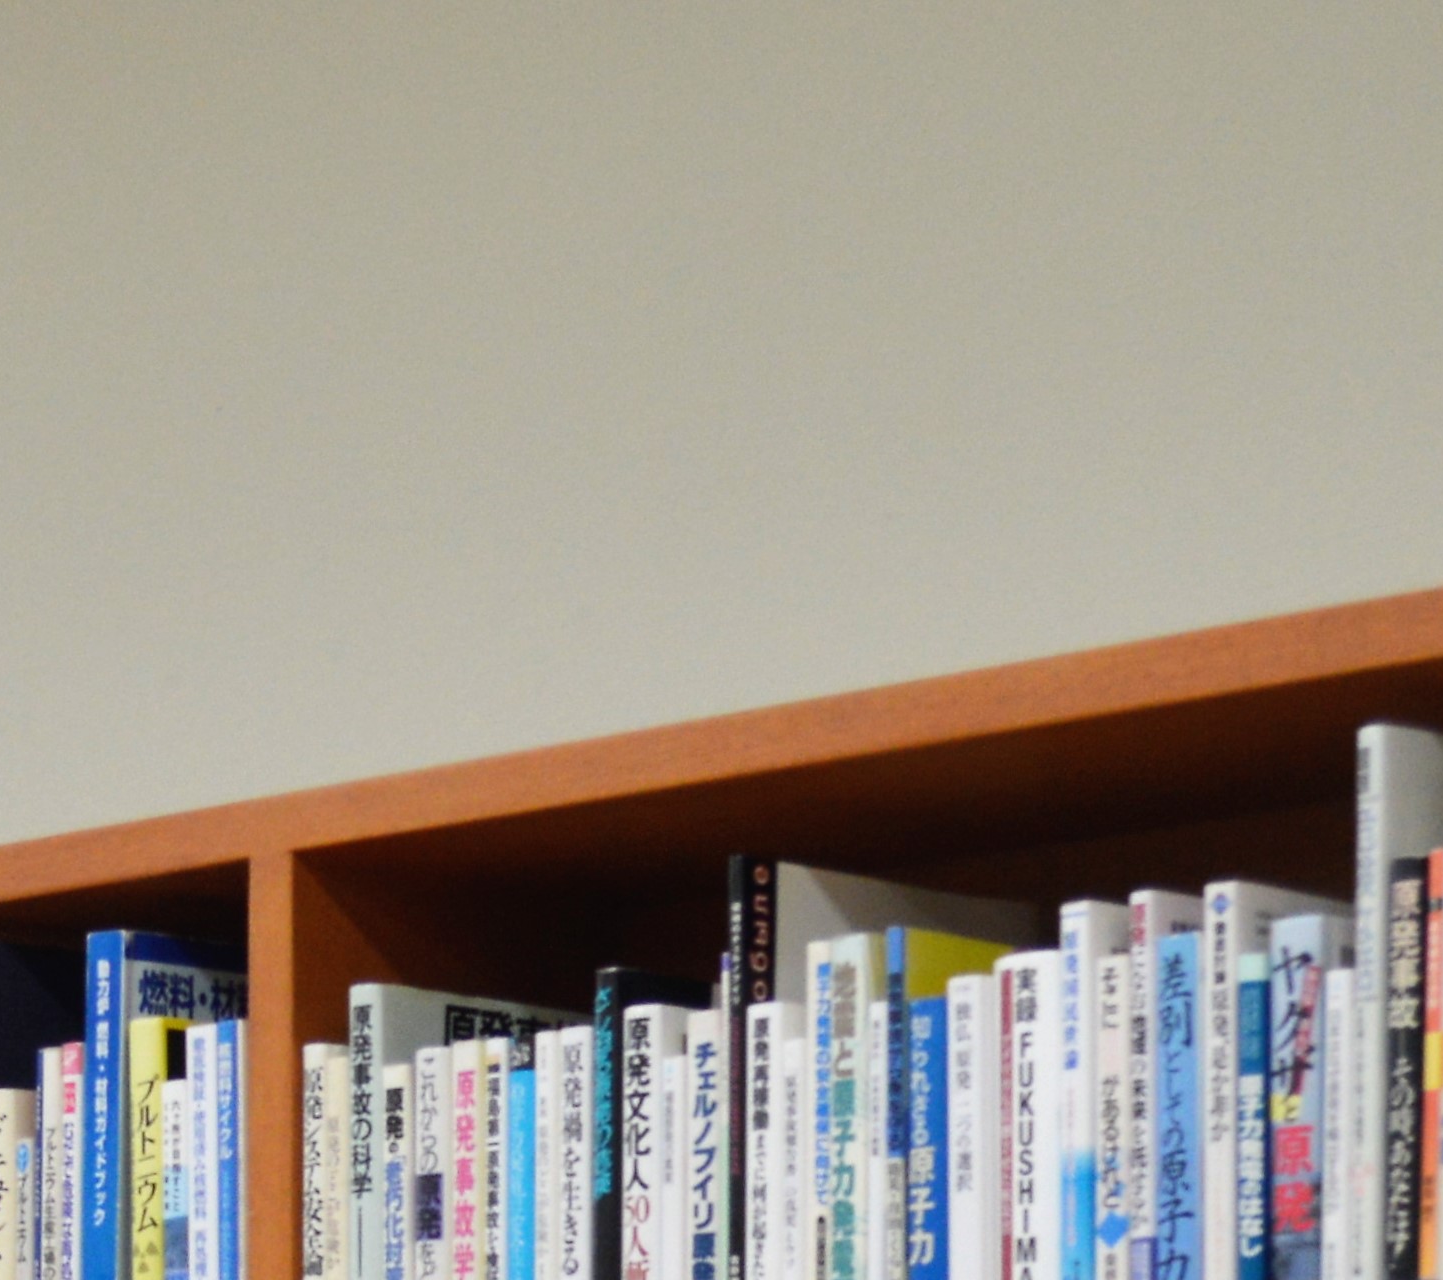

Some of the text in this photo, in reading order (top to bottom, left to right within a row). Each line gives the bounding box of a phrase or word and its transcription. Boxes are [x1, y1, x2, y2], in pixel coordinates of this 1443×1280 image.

[136, 1077, 159, 1231] プルトニウム
[350, 1006, 373, 1200] 原発事故の科学
